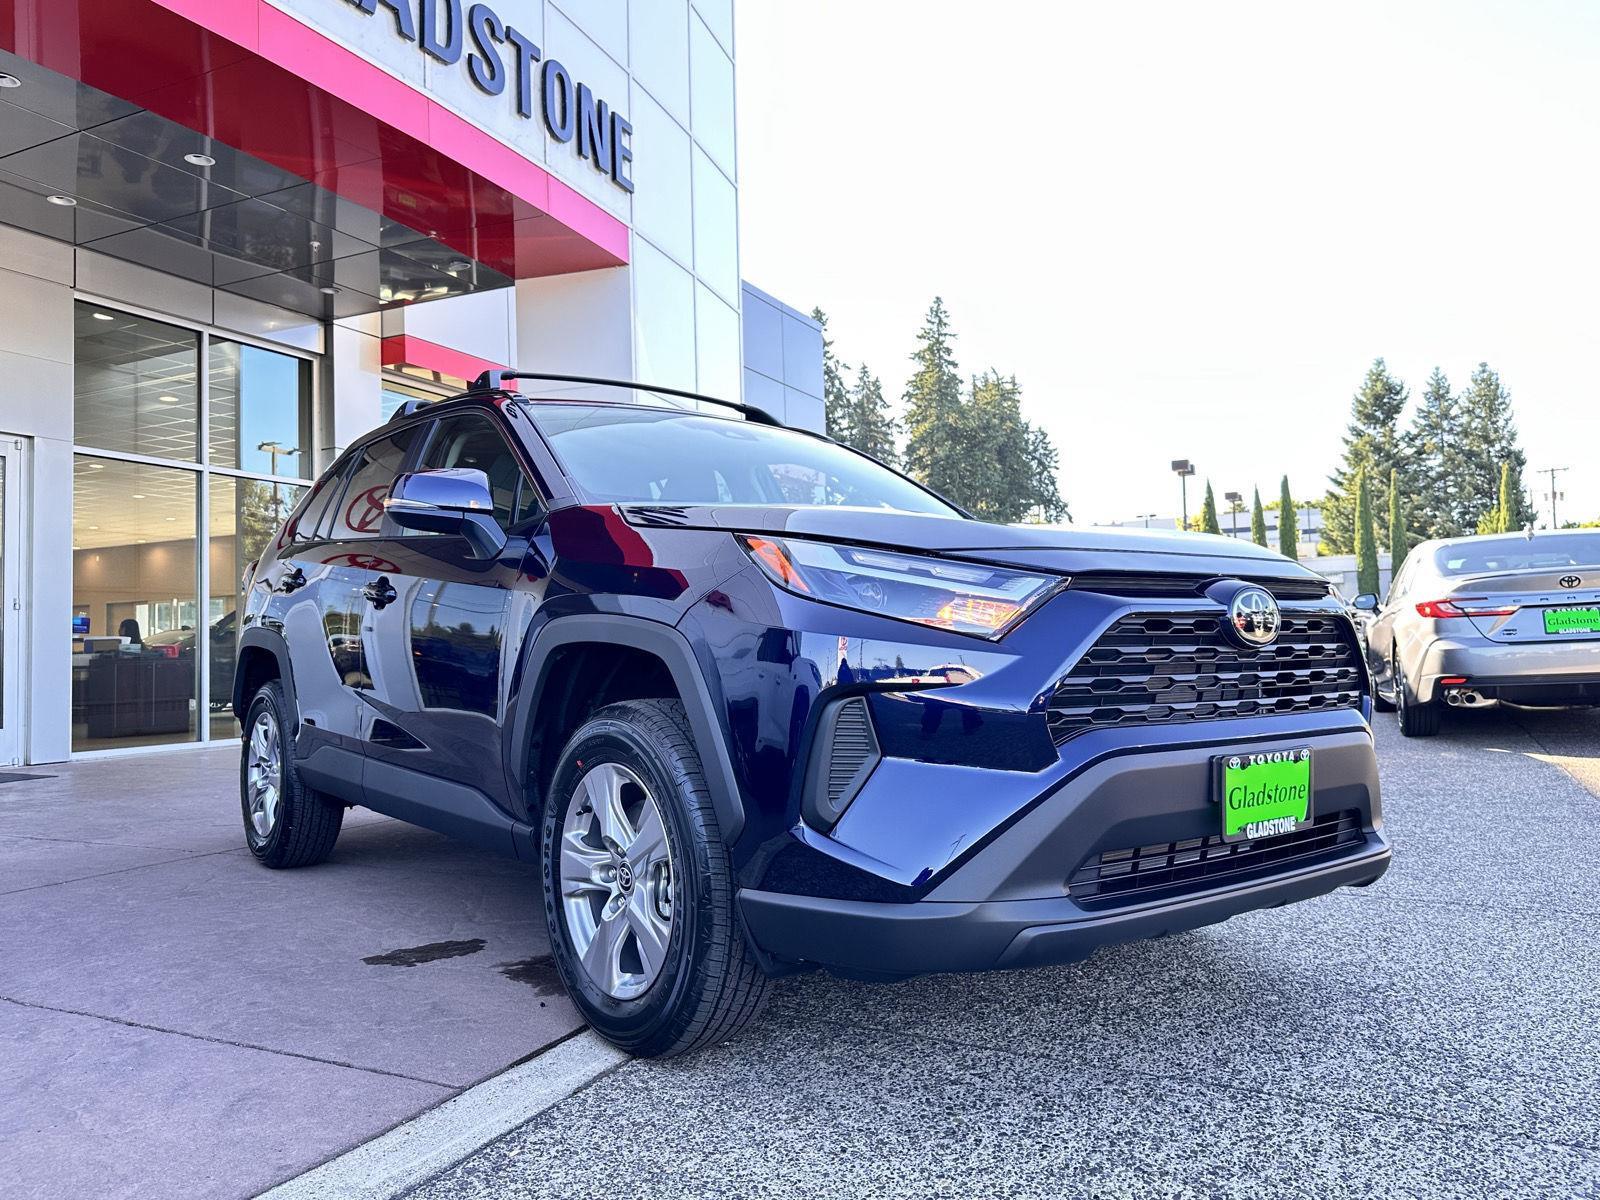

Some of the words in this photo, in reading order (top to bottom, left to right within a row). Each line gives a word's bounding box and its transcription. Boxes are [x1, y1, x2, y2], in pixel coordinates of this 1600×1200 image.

[345, 0, 634, 194] DSTONE
[1547, 617, 1599, 626] Gladstone
[1248, 751, 1295, 765] TOYOTA
[1229, 782, 1306, 810] Gladstone
[1246, 815, 1297, 839] GLADSTONE
